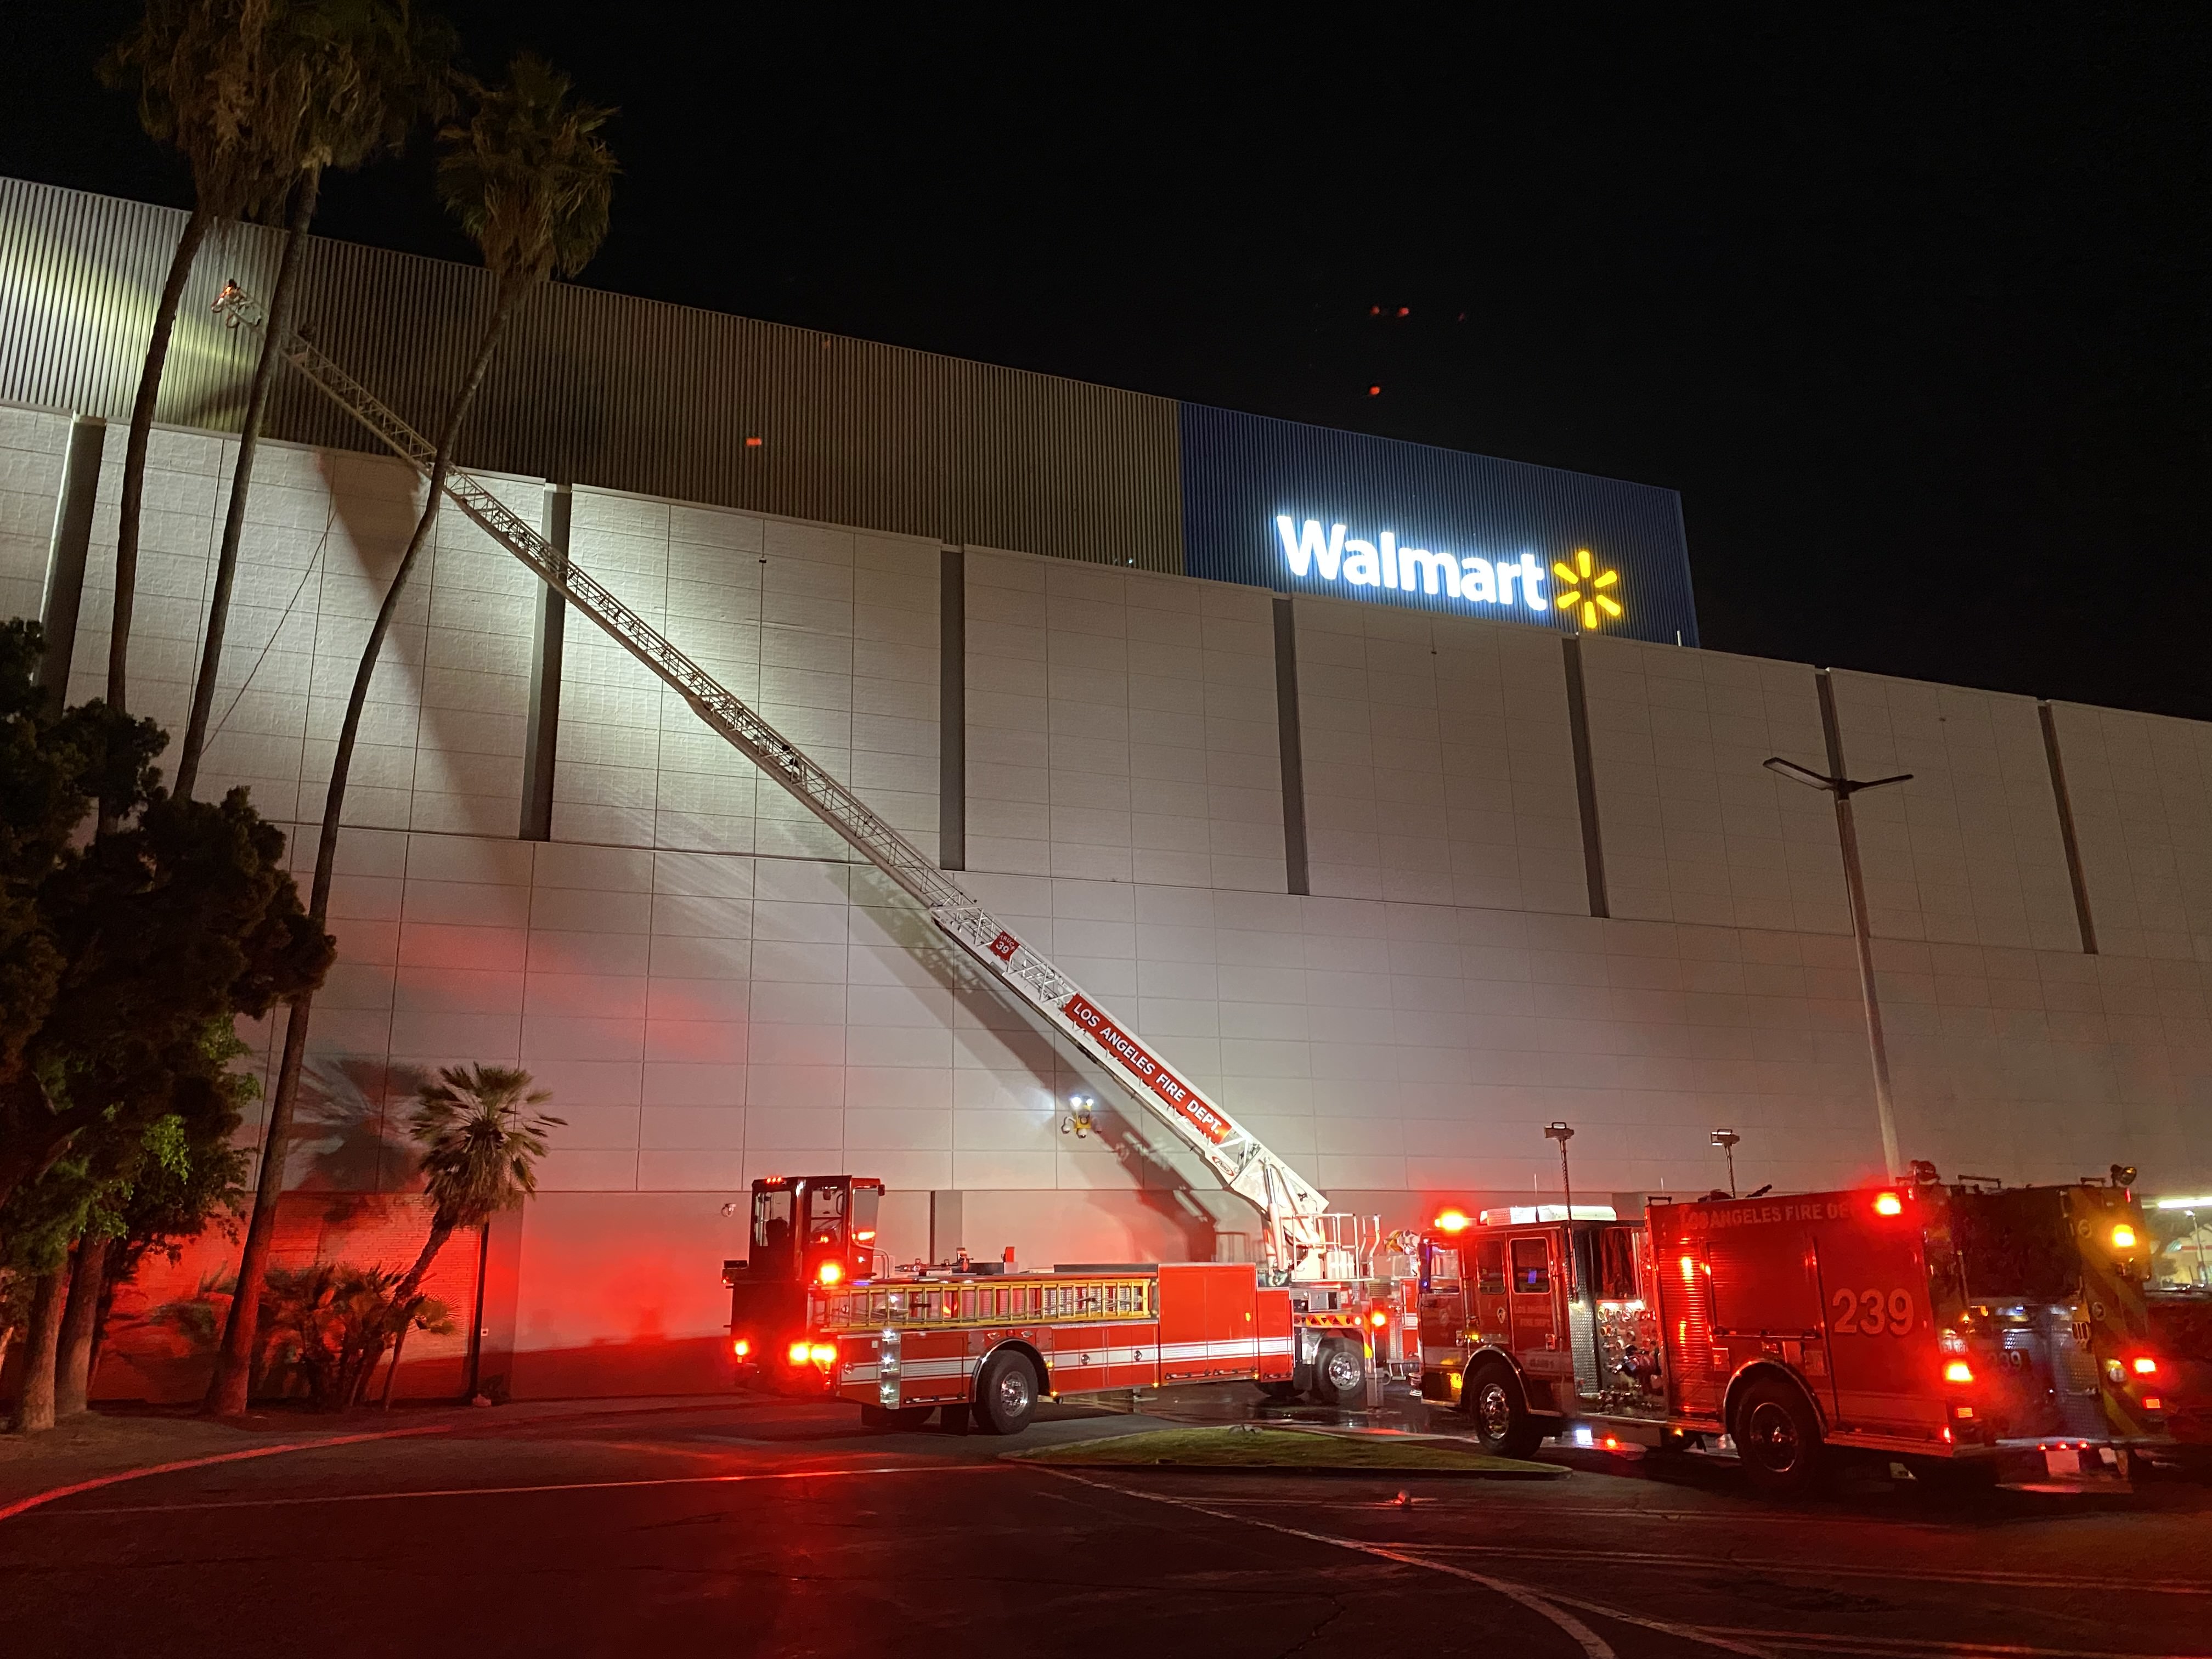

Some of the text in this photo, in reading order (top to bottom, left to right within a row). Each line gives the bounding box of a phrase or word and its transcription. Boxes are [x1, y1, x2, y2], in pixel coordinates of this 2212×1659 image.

[1277, 516, 1547, 611] Walmart
[996, 940, 1009, 954] 39
[1000, 935, 1015, 950] TRUCK
[1073, 1002, 1222, 1135] LOS ANGELES FIRE DEPT.
[1709, 1206, 1782, 1228] ANGELES
[1785, 1203, 1823, 1221] FIRE
[1832, 1288, 1914, 1335] 239
